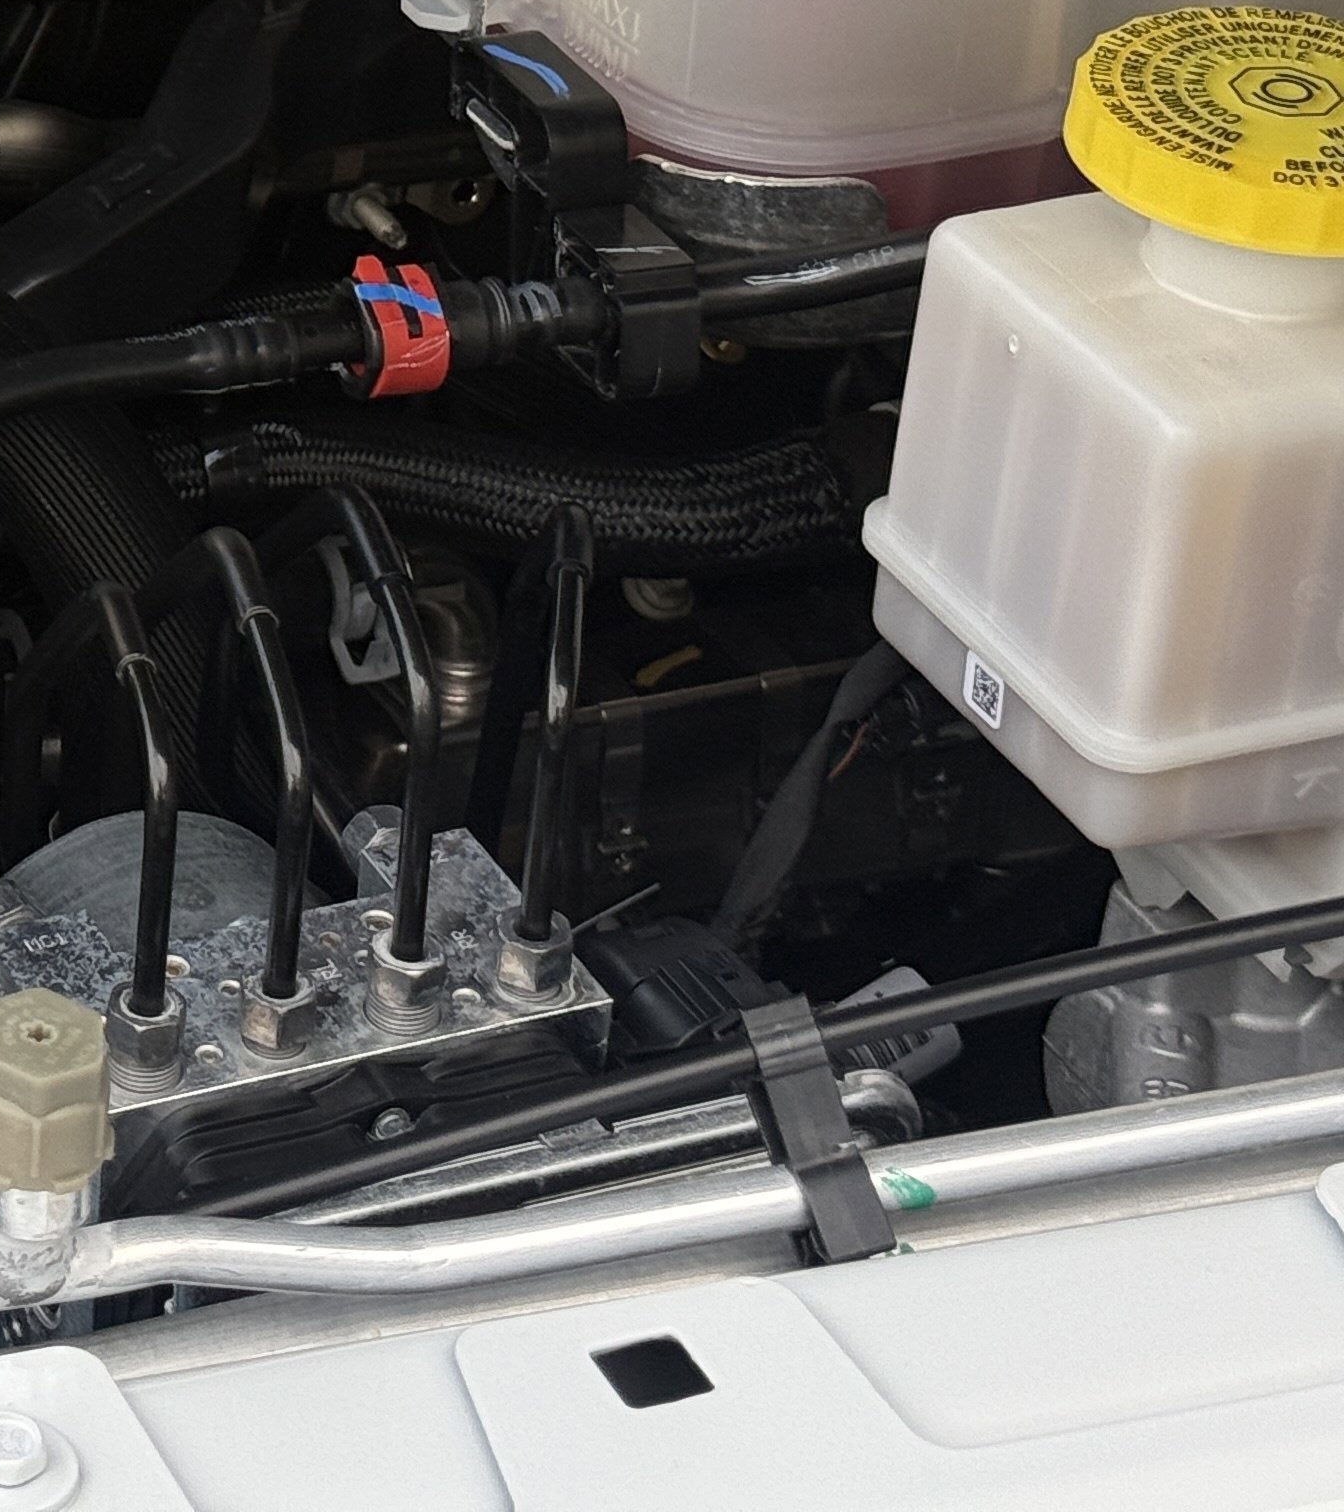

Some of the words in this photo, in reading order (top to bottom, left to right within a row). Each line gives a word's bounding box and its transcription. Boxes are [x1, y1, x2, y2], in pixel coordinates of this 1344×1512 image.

[1210, 6, 1242, 20] DE
[1120, 9, 1209, 40] BOUCHON
[1104, 33, 1134, 49] LE
[1141, 21, 1220, 53] UTILISER
[1167, 33, 1291, 60] PROVENANT
[1119, 49, 1155, 94] RETIRER
[1160, 55, 1183, 67] 3
[1150, 64, 1177, 86] DOT
[1182, 54, 1244, 126] CONTENANT
[1126, 94, 1156, 110] LE
[1153, 88, 1216, 130] LIQUIDE
[1141, 107, 1174, 125] DE
[1150, 135, 1185, 153] EN
[1160, 123, 1234, 155] AVANT
[1208, 125, 1244, 144] DU
[1180, 148, 1235, 172] MISE
[1273, 171, 1318, 187] DOT
[1323, 175, 1340, 187] 3
